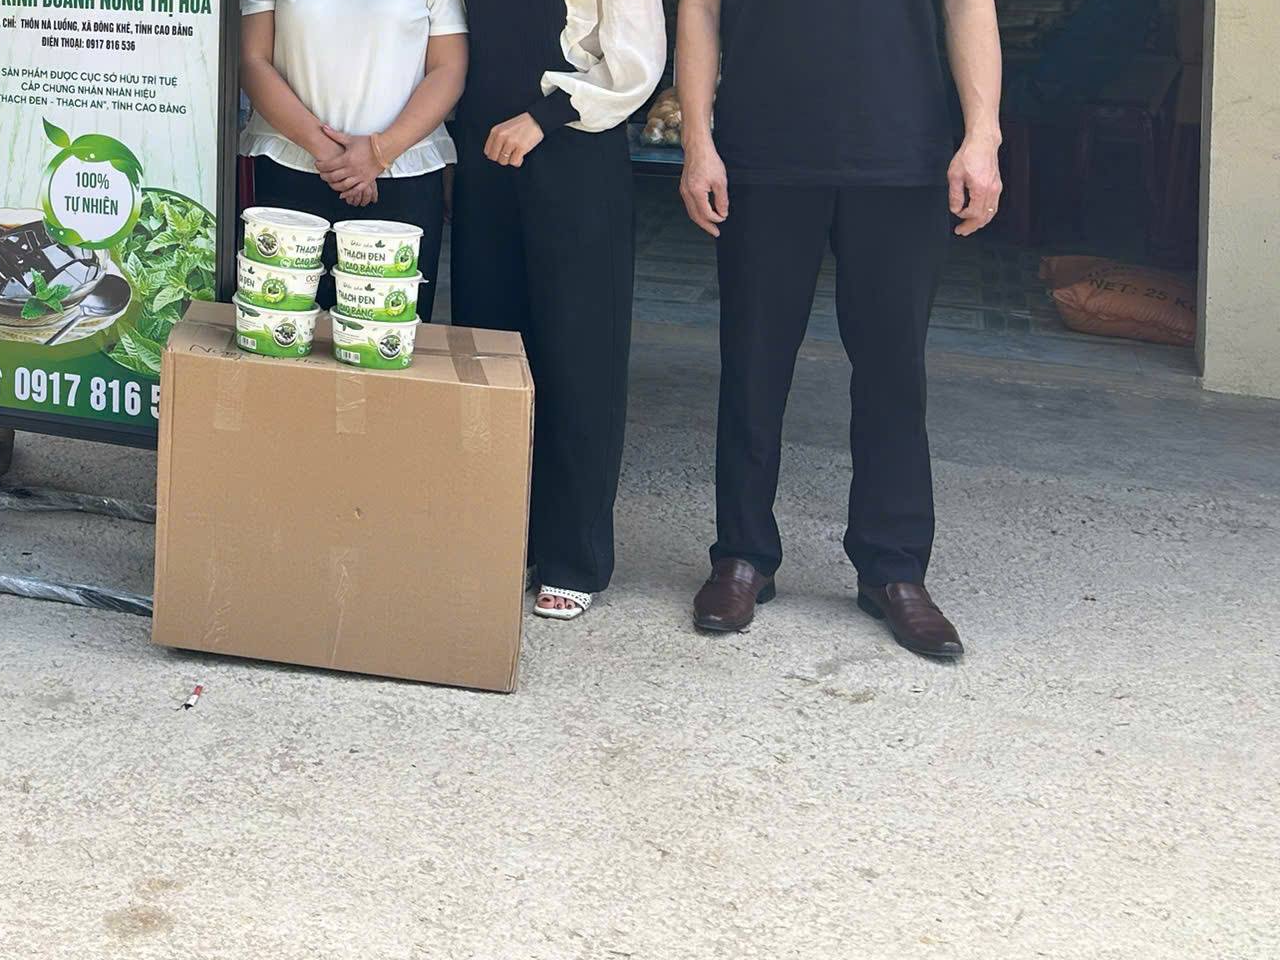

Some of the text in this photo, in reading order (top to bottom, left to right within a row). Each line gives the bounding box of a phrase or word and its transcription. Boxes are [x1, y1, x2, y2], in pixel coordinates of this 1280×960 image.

[154, 24, 170, 36] CAO
[60, 37, 85, 50] THOẠI:
[86, 39, 104, 49] 0917
[106, 40, 120, 51] 816
[121, 40, 136, 52] 536
[1, 66, 20, 77] SẢN
[50, 70, 79, 82] ĐƯỢC
[80, 72, 101, 83] CỤC
[28, 95, 48, 106] ĐEN
[135, 102, 157, 113] CAO
[75, 172, 110, 190] 100%
[64, 195, 119, 216] TỰ NHIÊN
[343, 247, 386, 262] THẠCH ĐEN
[345, 262, 359, 272] CAO
[358, 295, 376, 305] ĐEN
[14, 366, 81, 408] 0917
[89, 375, 141, 417] 816
